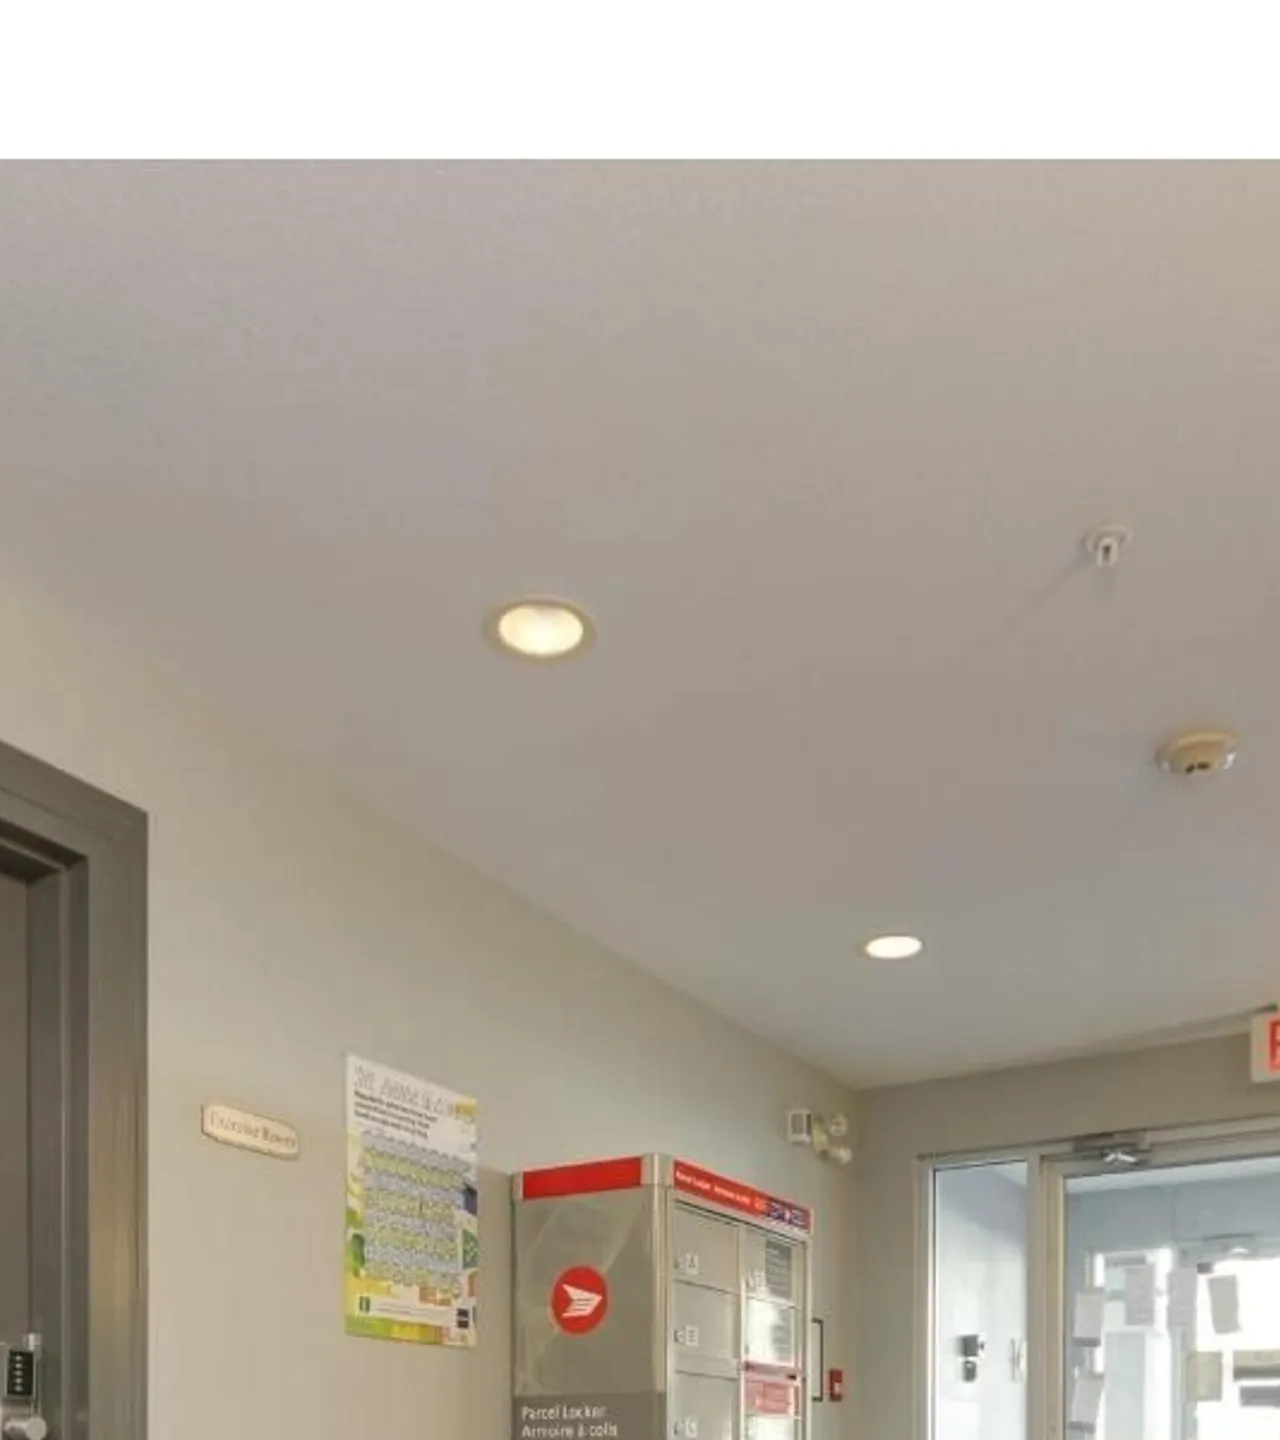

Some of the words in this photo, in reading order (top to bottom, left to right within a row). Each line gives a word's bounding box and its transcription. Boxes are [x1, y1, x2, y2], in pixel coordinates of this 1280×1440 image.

[522, 1405, 561, 1420] Parcel
[563, 1404, 607, 1420] Locker
[522, 1423, 574, 1438] Armoire
